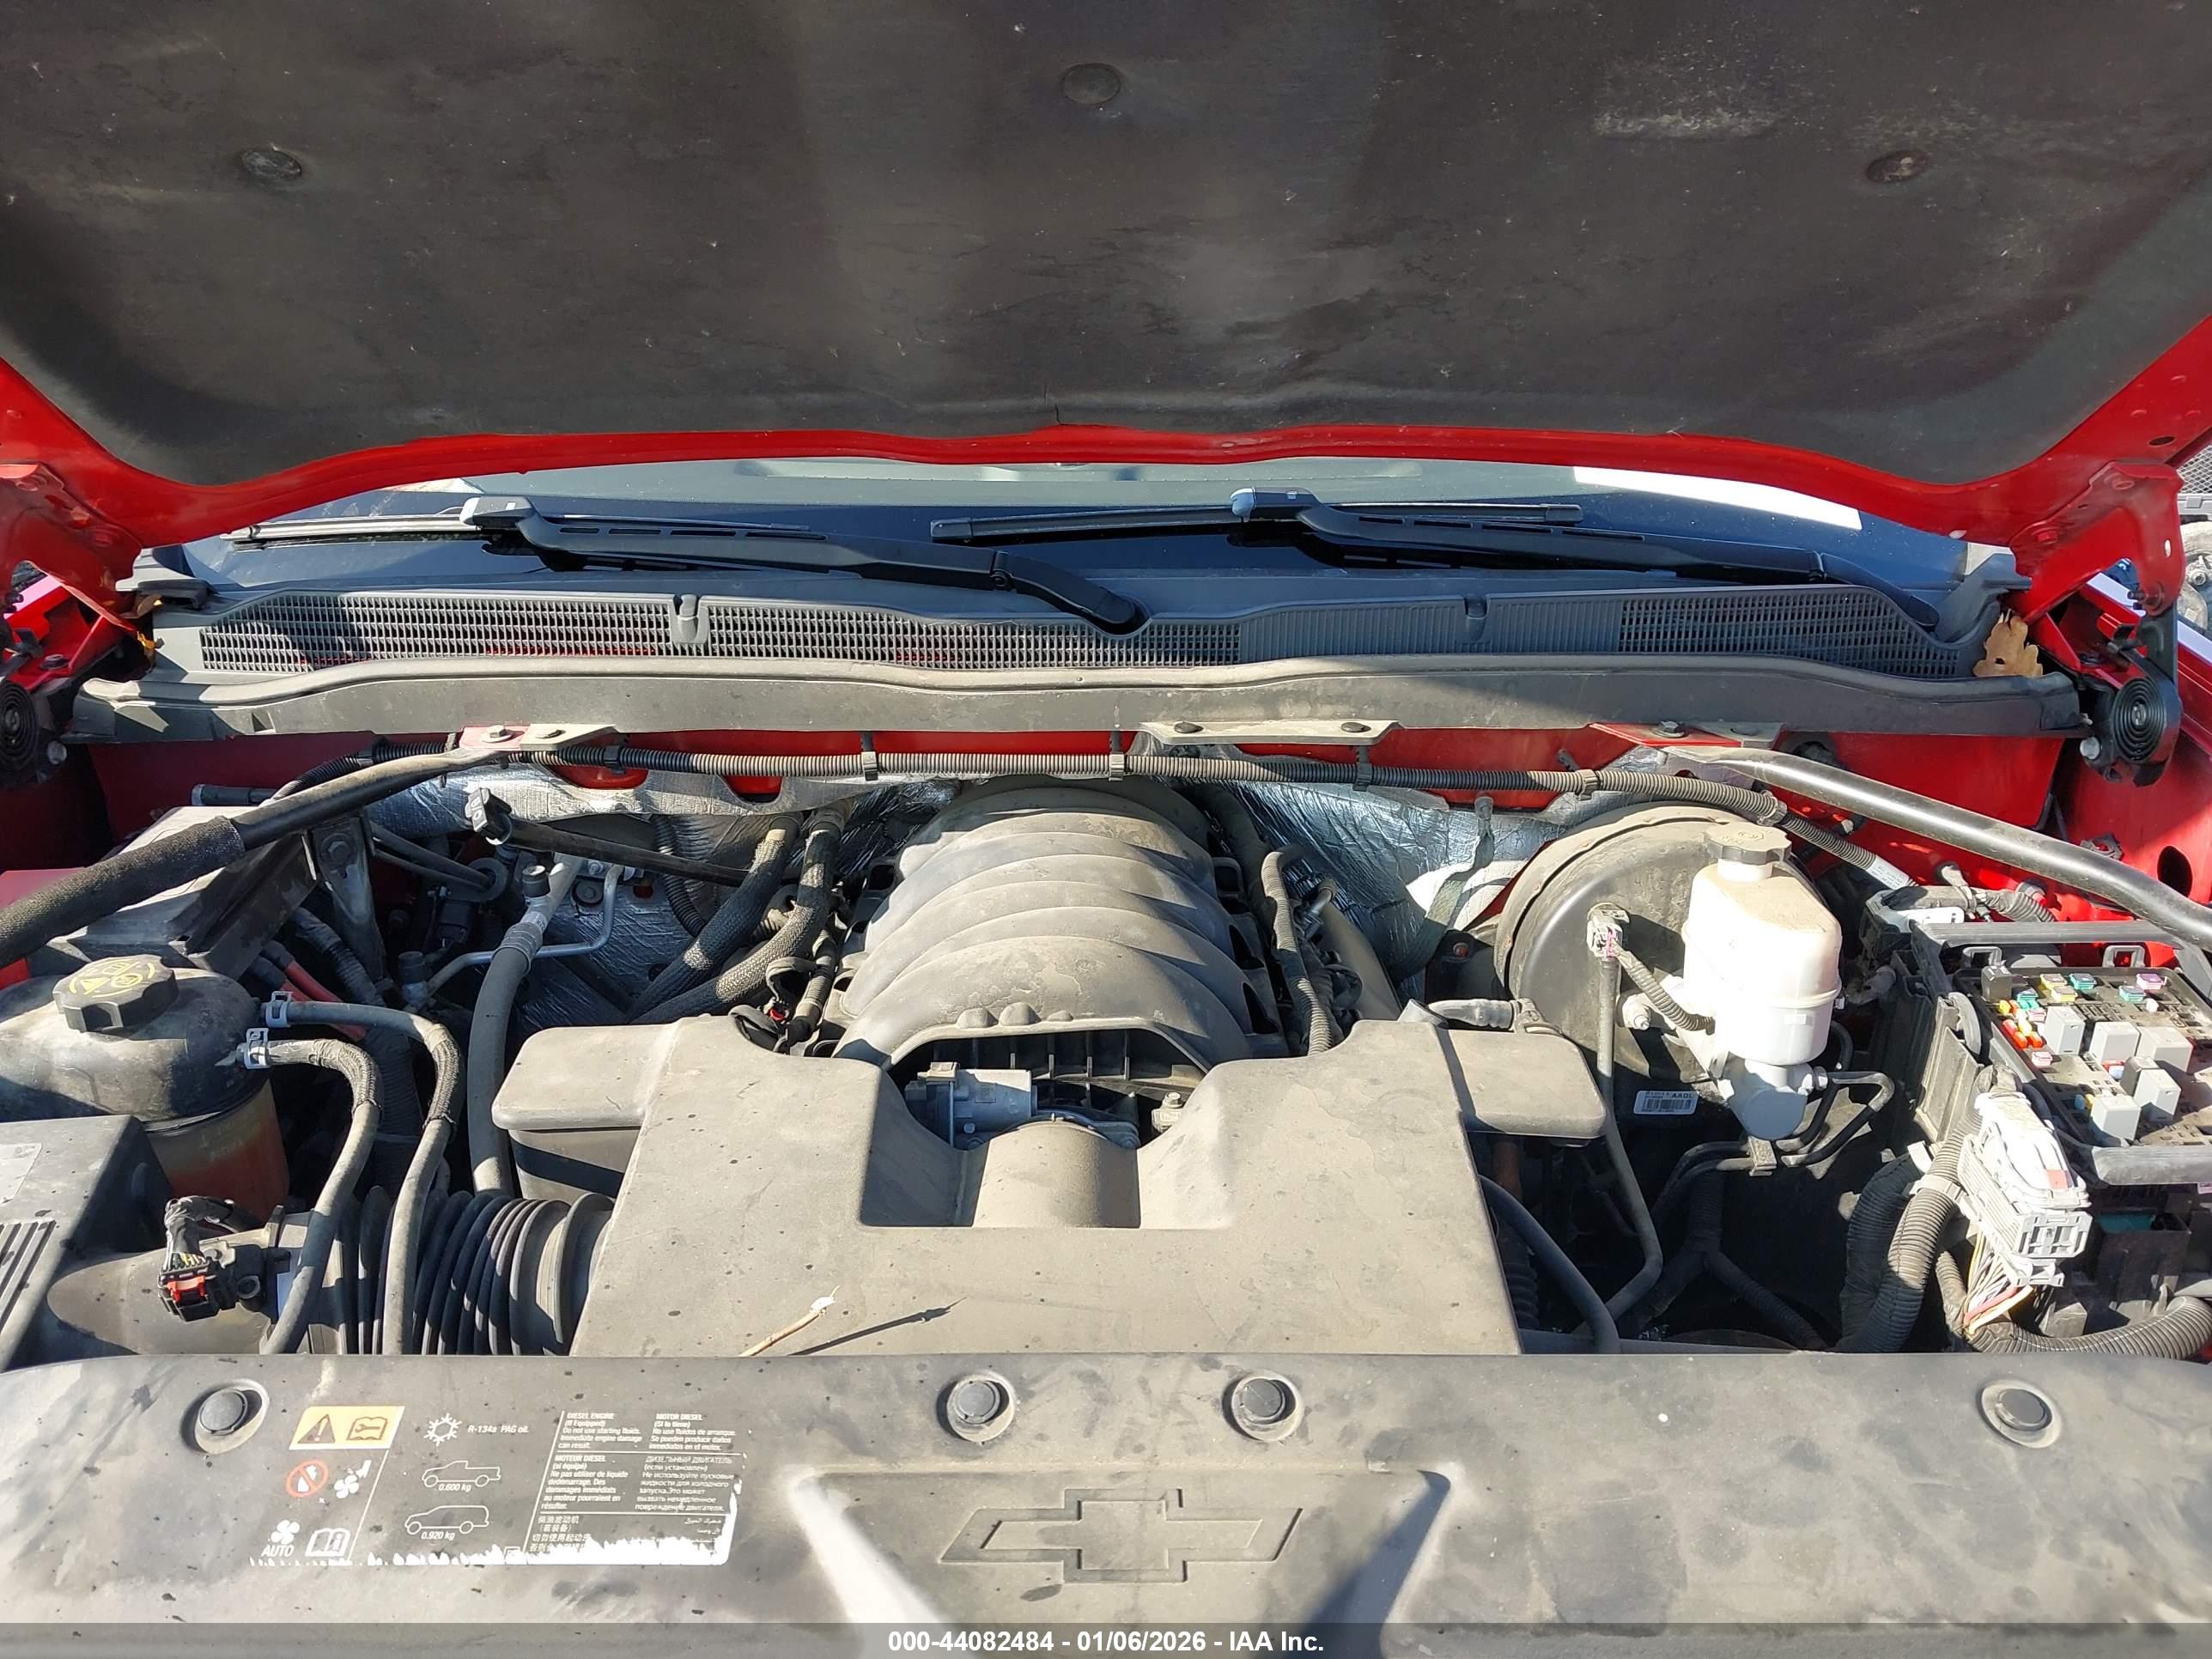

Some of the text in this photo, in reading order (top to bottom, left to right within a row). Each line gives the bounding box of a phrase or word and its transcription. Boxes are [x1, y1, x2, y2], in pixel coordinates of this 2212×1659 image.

[461, 1484, 471, 1492] kg
[421, 1531, 455, 1540] 0.920 kg
[261, 1545, 294, 1557] AUTO
